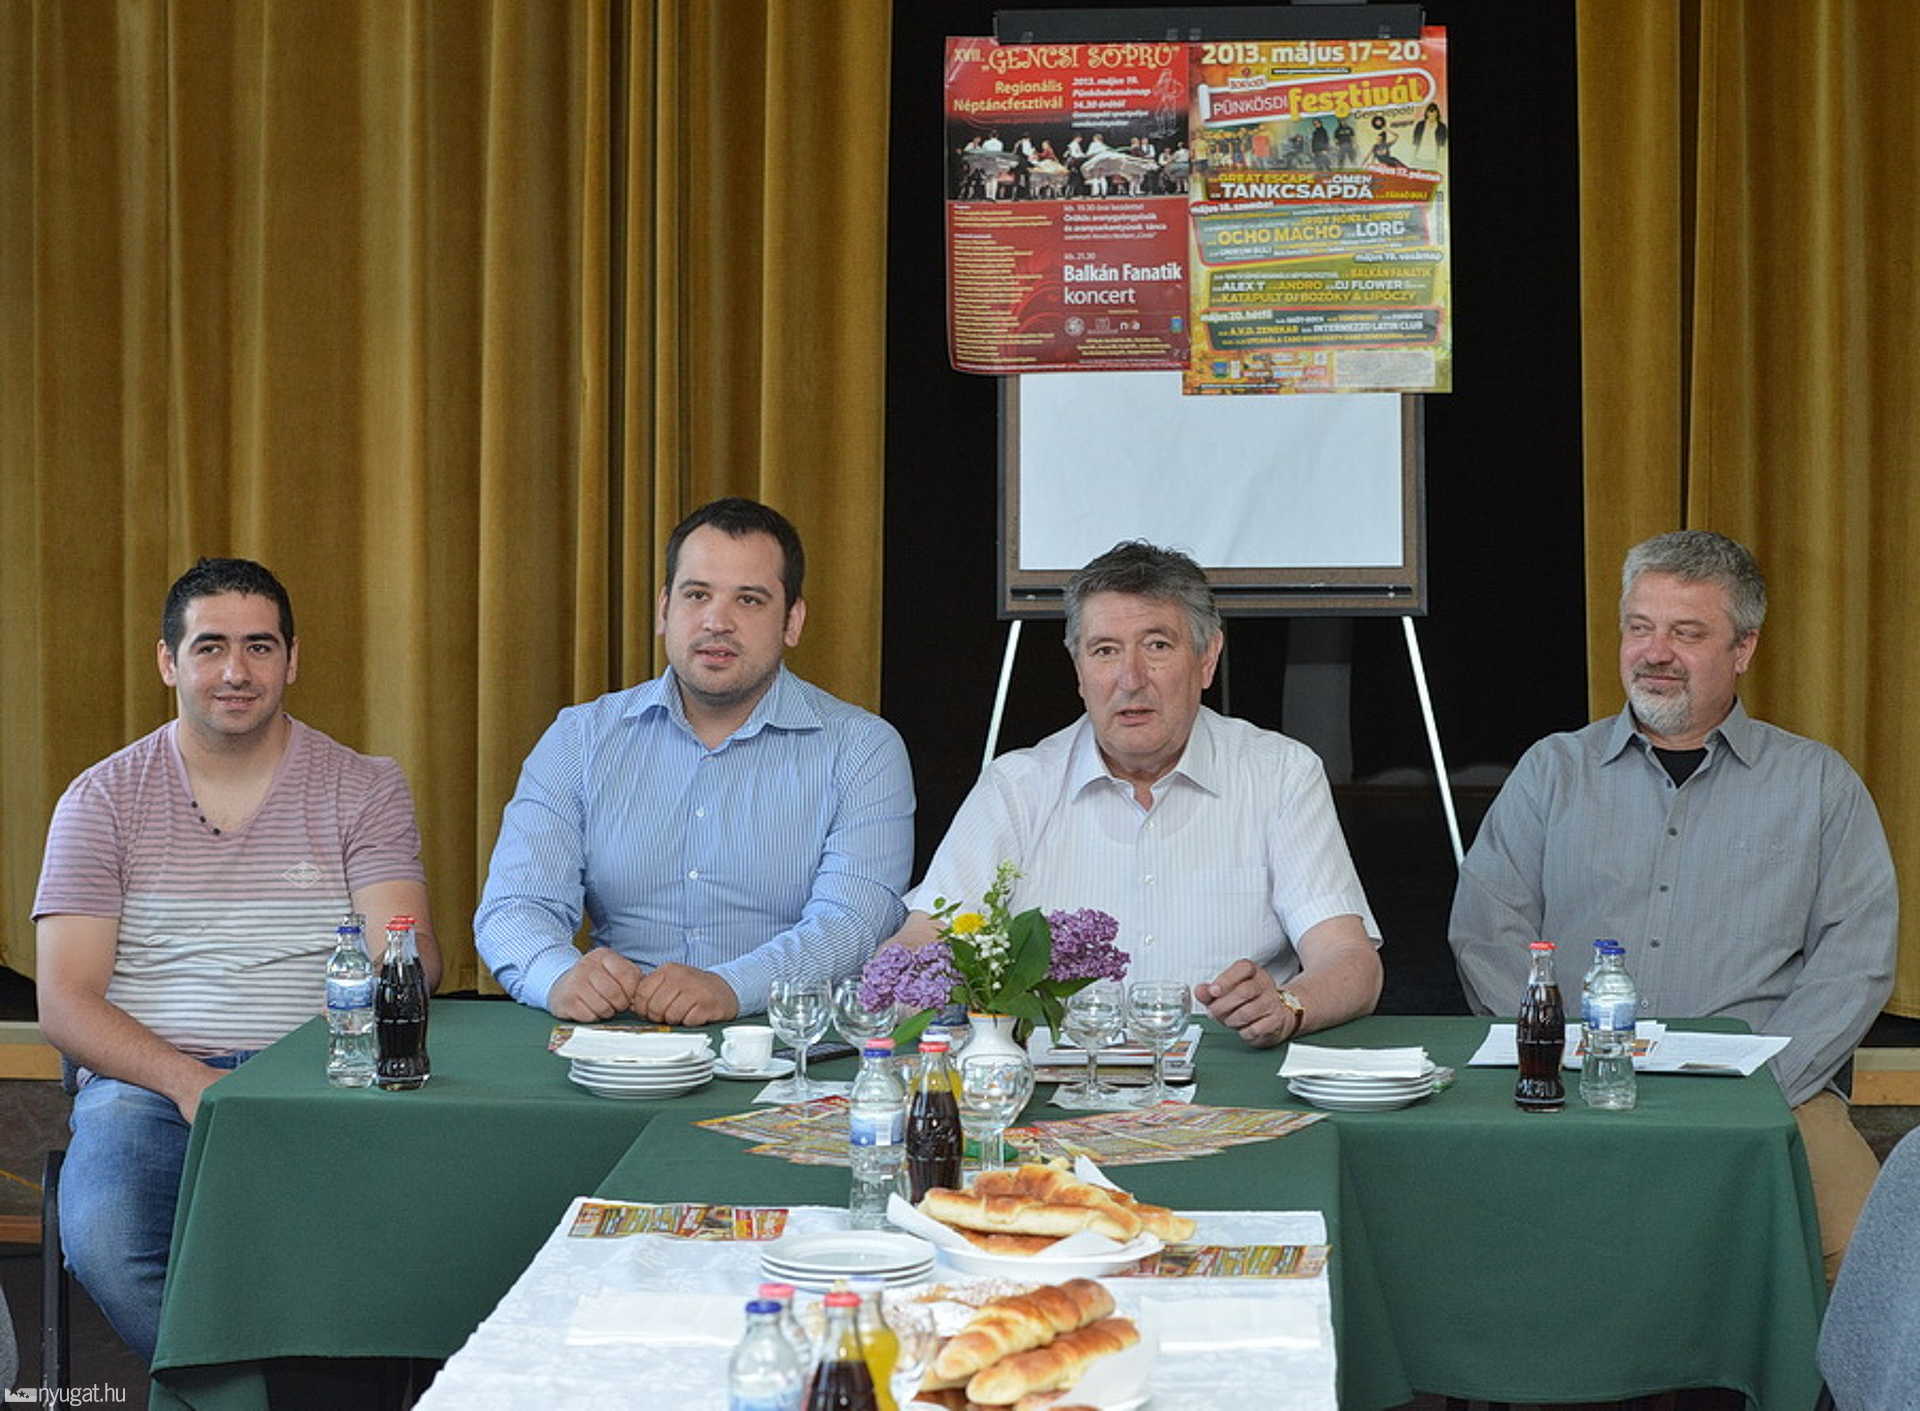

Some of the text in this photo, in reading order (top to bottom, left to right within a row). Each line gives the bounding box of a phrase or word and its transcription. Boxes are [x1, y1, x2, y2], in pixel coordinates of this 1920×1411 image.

[1202, 43, 1266, 64] 2013.
[1271, 41, 1344, 65] május
[995, 80, 1063, 96] Regionális
[1288, 76, 1424, 121] fesztivál
[1217, 228, 1271, 246] OCHO
[1275, 224, 1343, 242] MACHO
[1356, 220, 1406, 237] LORD
[1063, 261, 1182, 283] Balkán Fanatik
[1064, 286, 1136, 304] koncert
